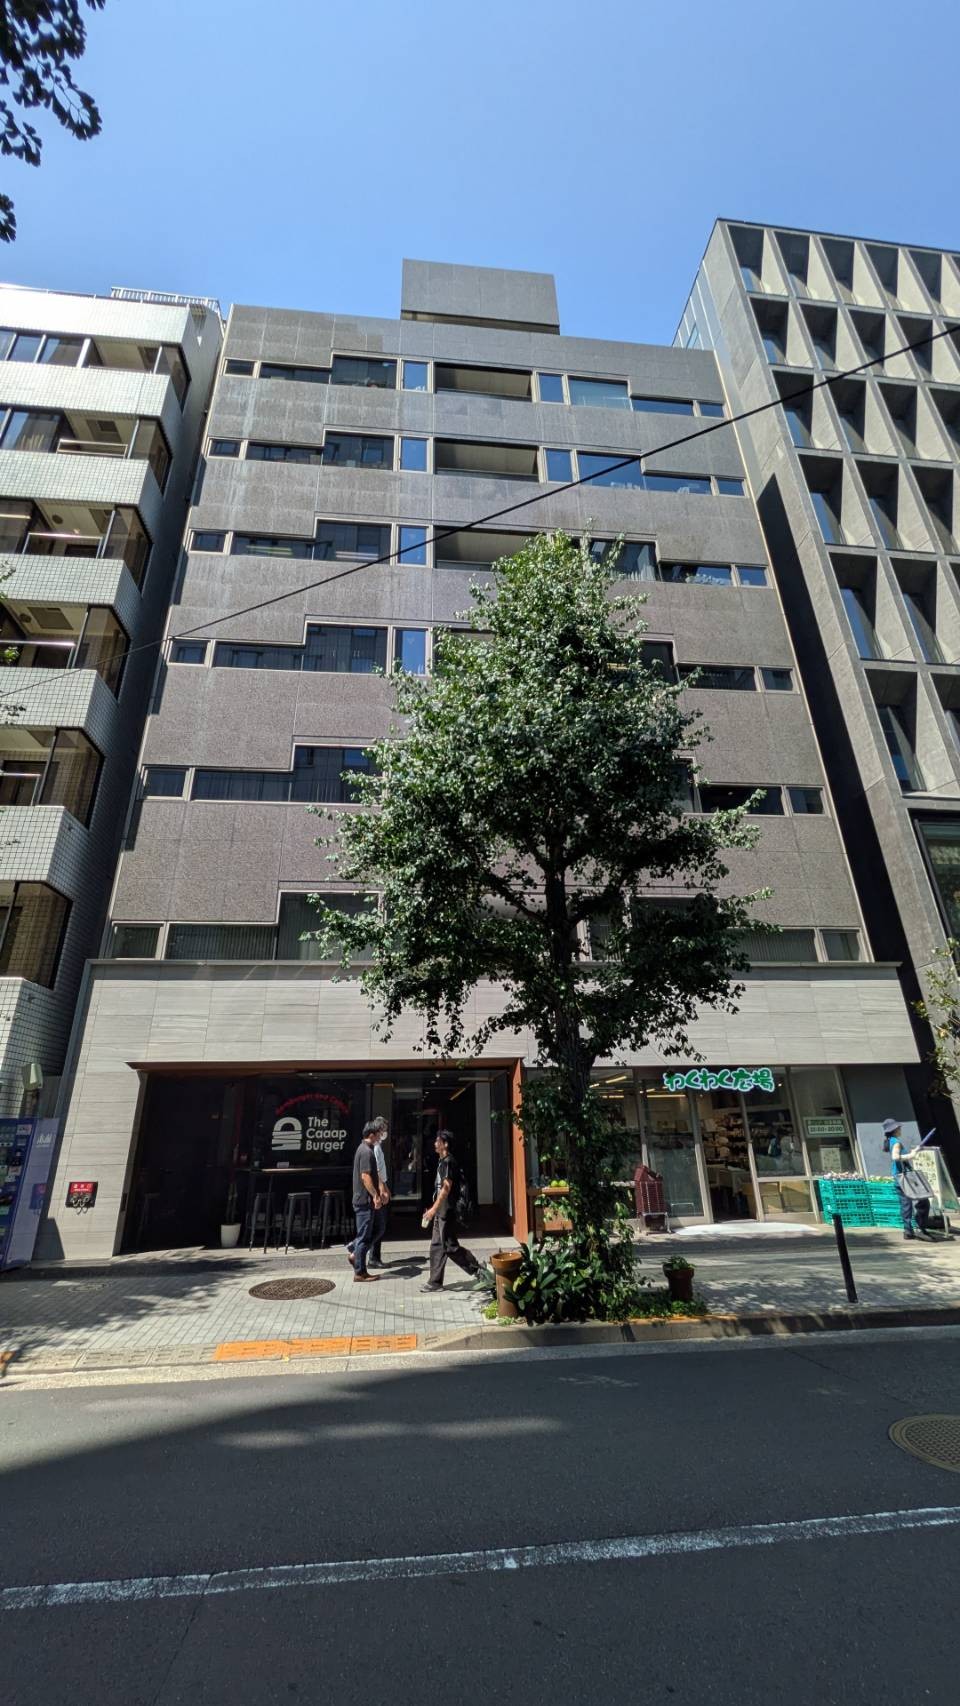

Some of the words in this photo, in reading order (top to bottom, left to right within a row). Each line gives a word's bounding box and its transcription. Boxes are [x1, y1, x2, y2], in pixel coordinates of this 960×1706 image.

[663, 1068, 774, 1092] わくわく広場
[307, 1117, 329, 1127] The
[306, 1128, 347, 1140] Caaap
[305, 1140, 345, 1152] Burger
